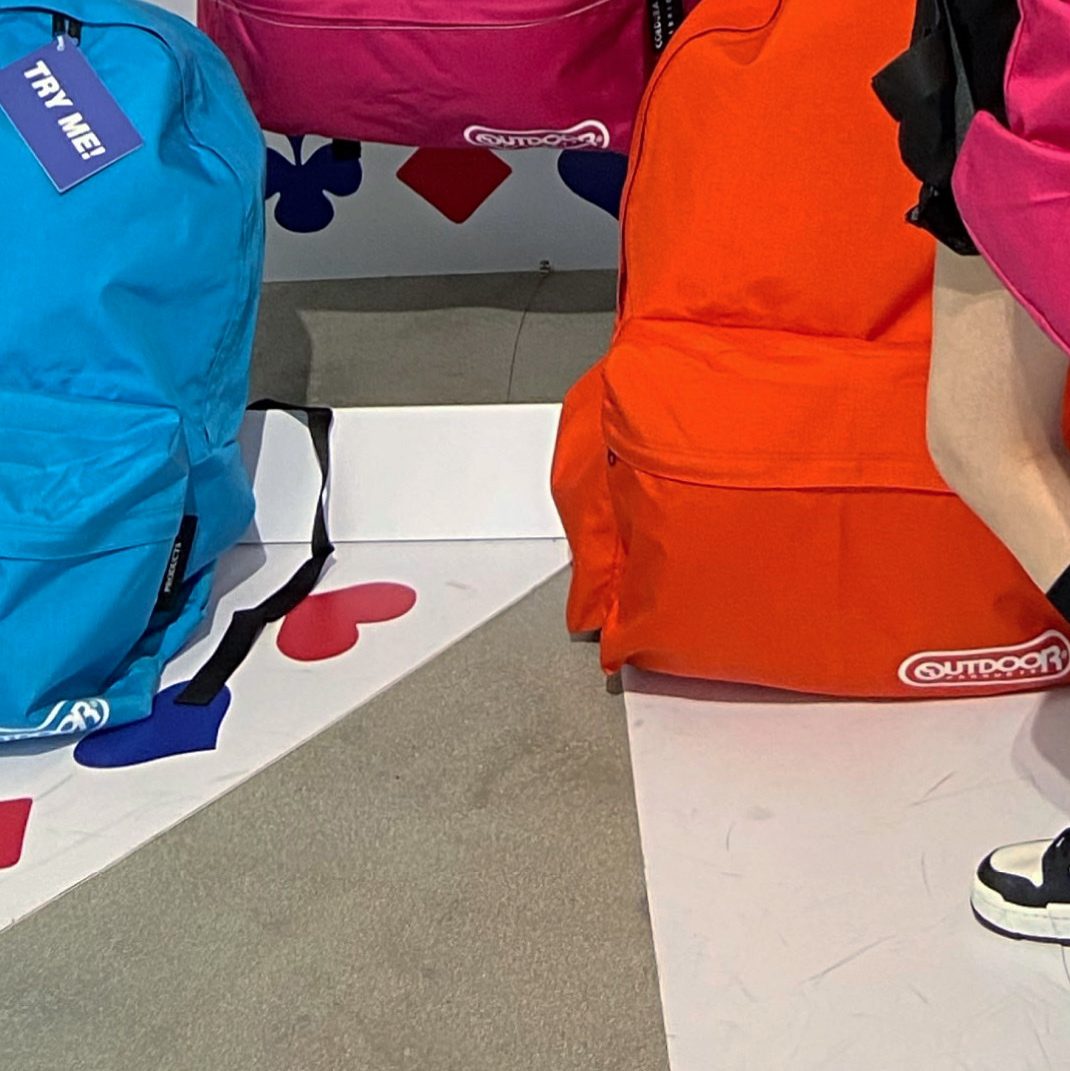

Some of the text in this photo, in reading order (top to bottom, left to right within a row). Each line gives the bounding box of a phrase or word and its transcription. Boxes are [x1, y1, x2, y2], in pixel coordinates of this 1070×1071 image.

[24, 60, 106, 160] TRY ME!
[914, 645, 1063, 680] OUTDOOR
